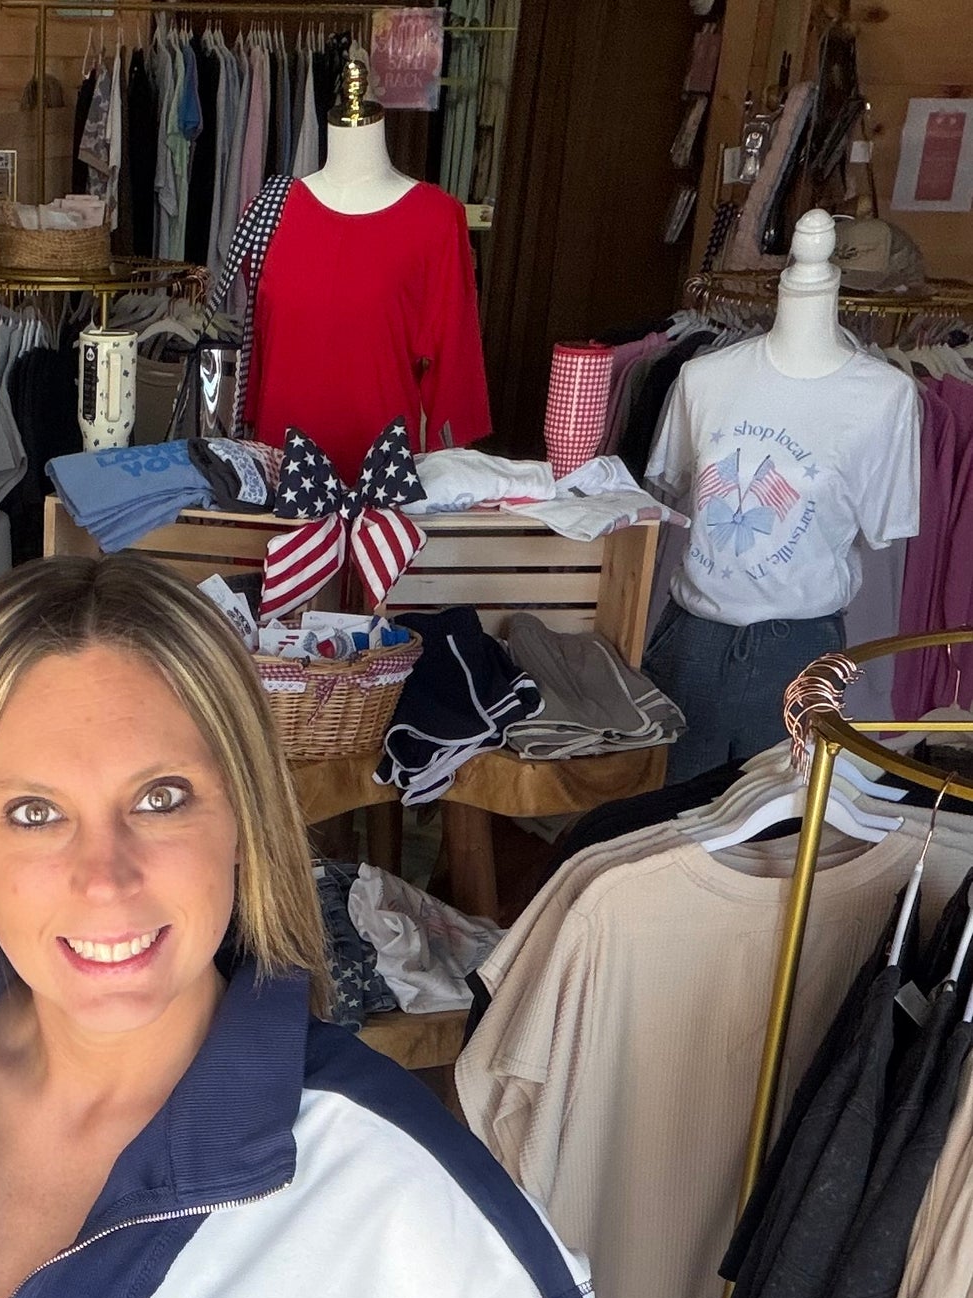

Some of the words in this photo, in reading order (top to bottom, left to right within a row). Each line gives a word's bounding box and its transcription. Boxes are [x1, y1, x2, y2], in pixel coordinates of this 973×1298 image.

[385, 72, 423, 88] RACK
[734, 420, 774, 441] shop
[775, 428, 811, 461] local
[690, 547, 715, 575] love
